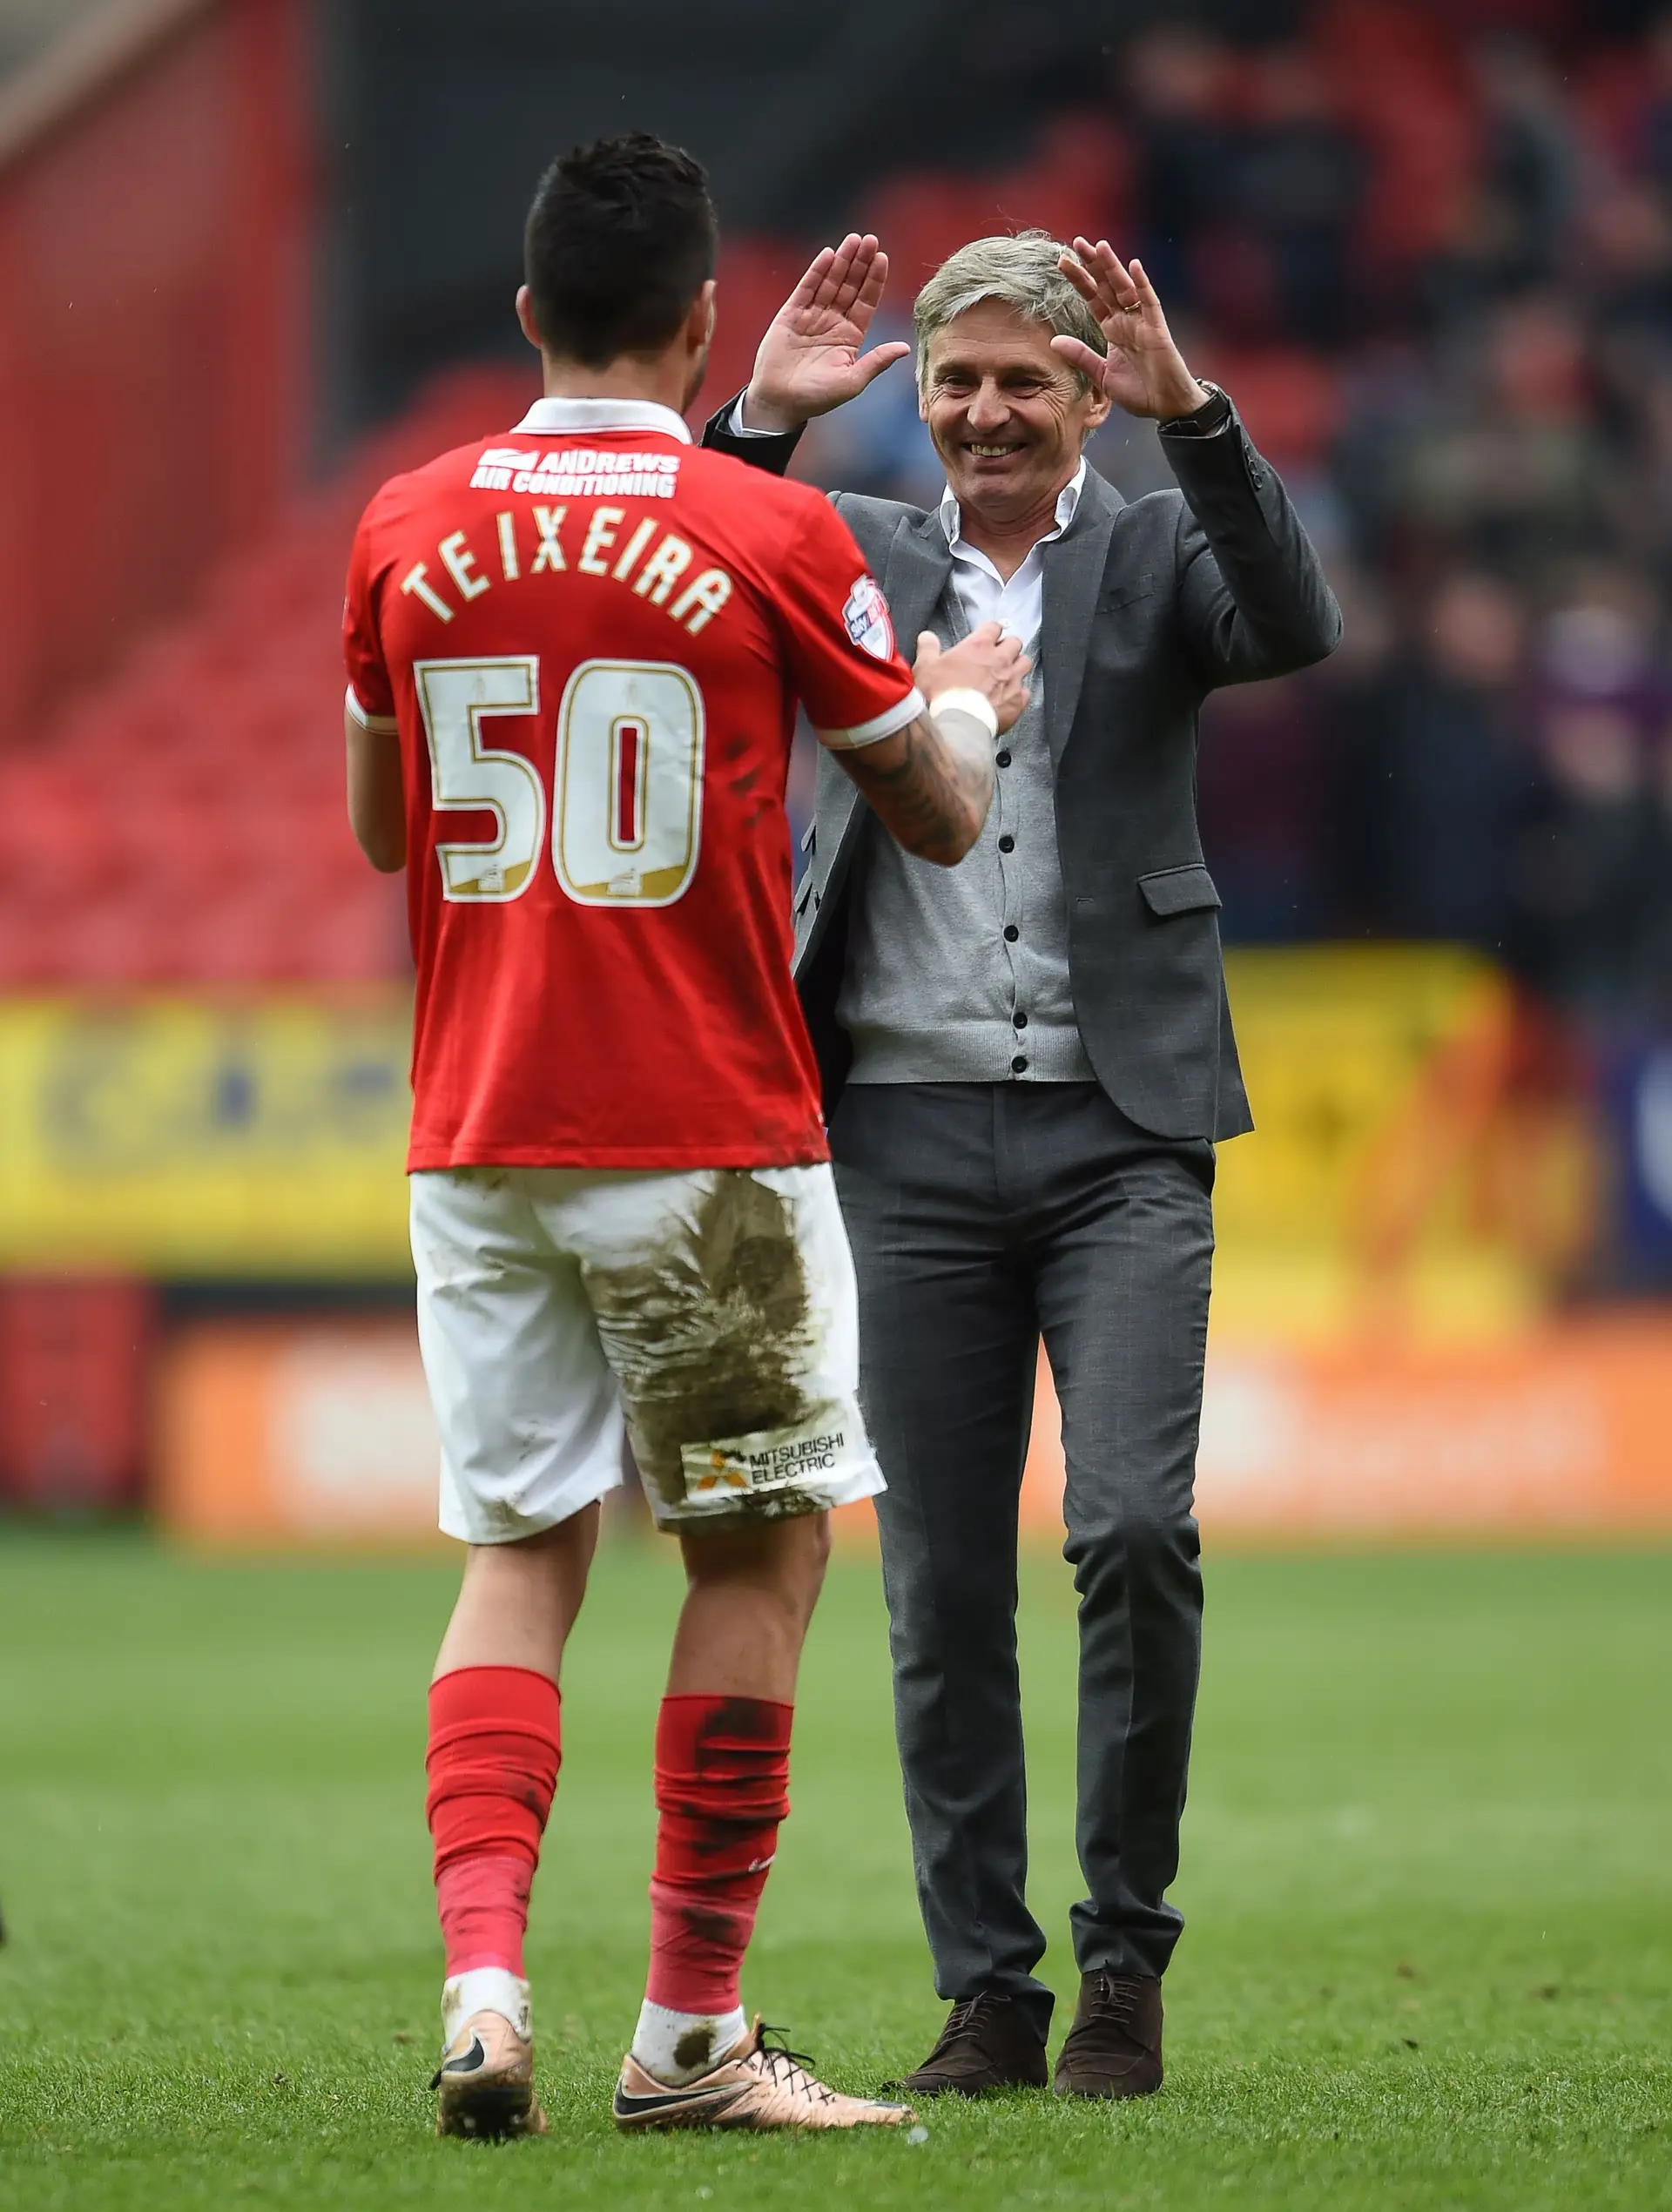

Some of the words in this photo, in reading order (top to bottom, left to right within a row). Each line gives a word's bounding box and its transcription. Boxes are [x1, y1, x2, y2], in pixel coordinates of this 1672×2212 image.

[536, 450, 681, 474] ANDREWS
[469, 467, 514, 489] AIR
[512, 472, 676, 499] CONDITIONING
[401, 506, 733, 636] TEIXEIRA
[413, 655, 705, 907] 50
[750, 1433, 845, 1467] MITSUBISHI
[752, 1453, 835, 1485] ELECTRIC
